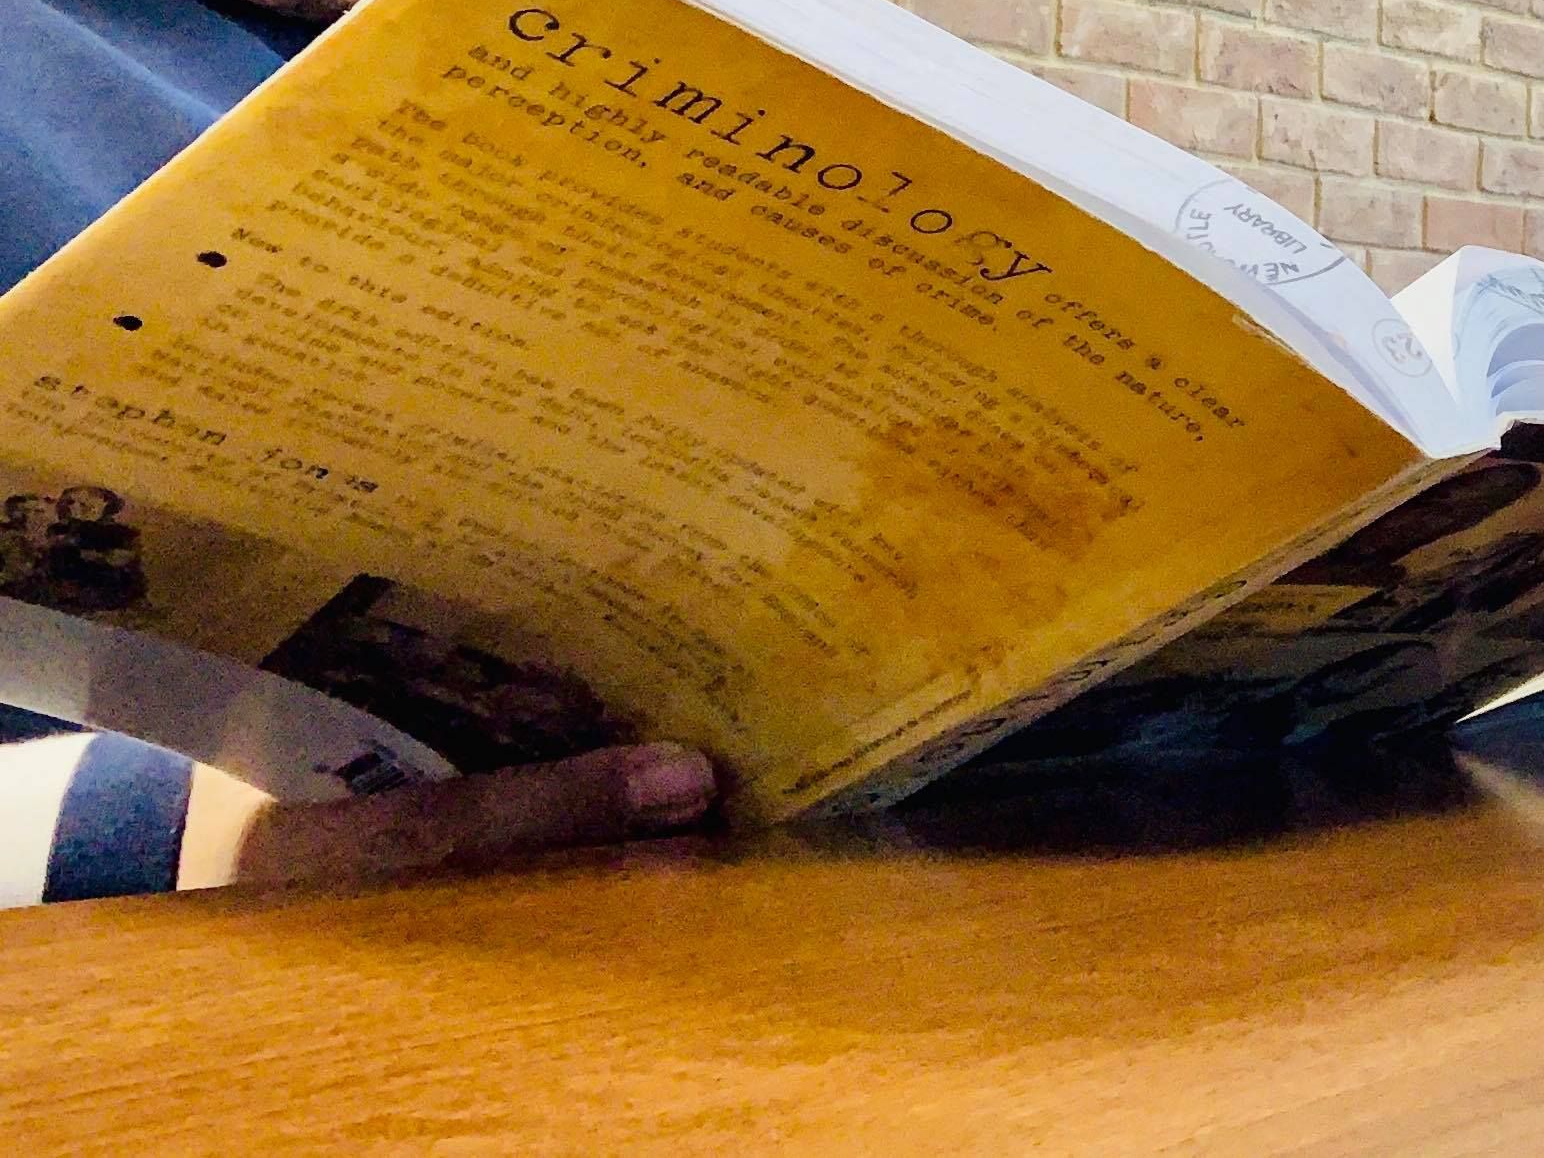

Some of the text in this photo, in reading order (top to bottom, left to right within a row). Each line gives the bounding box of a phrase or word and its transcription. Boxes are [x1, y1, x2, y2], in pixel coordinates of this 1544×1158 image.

[440, 63, 1006, 331] perception, and causes of crime.
[464, 43, 1210, 442] and highly readable discussion of the nature,
[1224, 203, 1307, 255] LIBRARY
[1040, 289, 1139, 351] offers
[1170, 374, 1248, 430] clear
